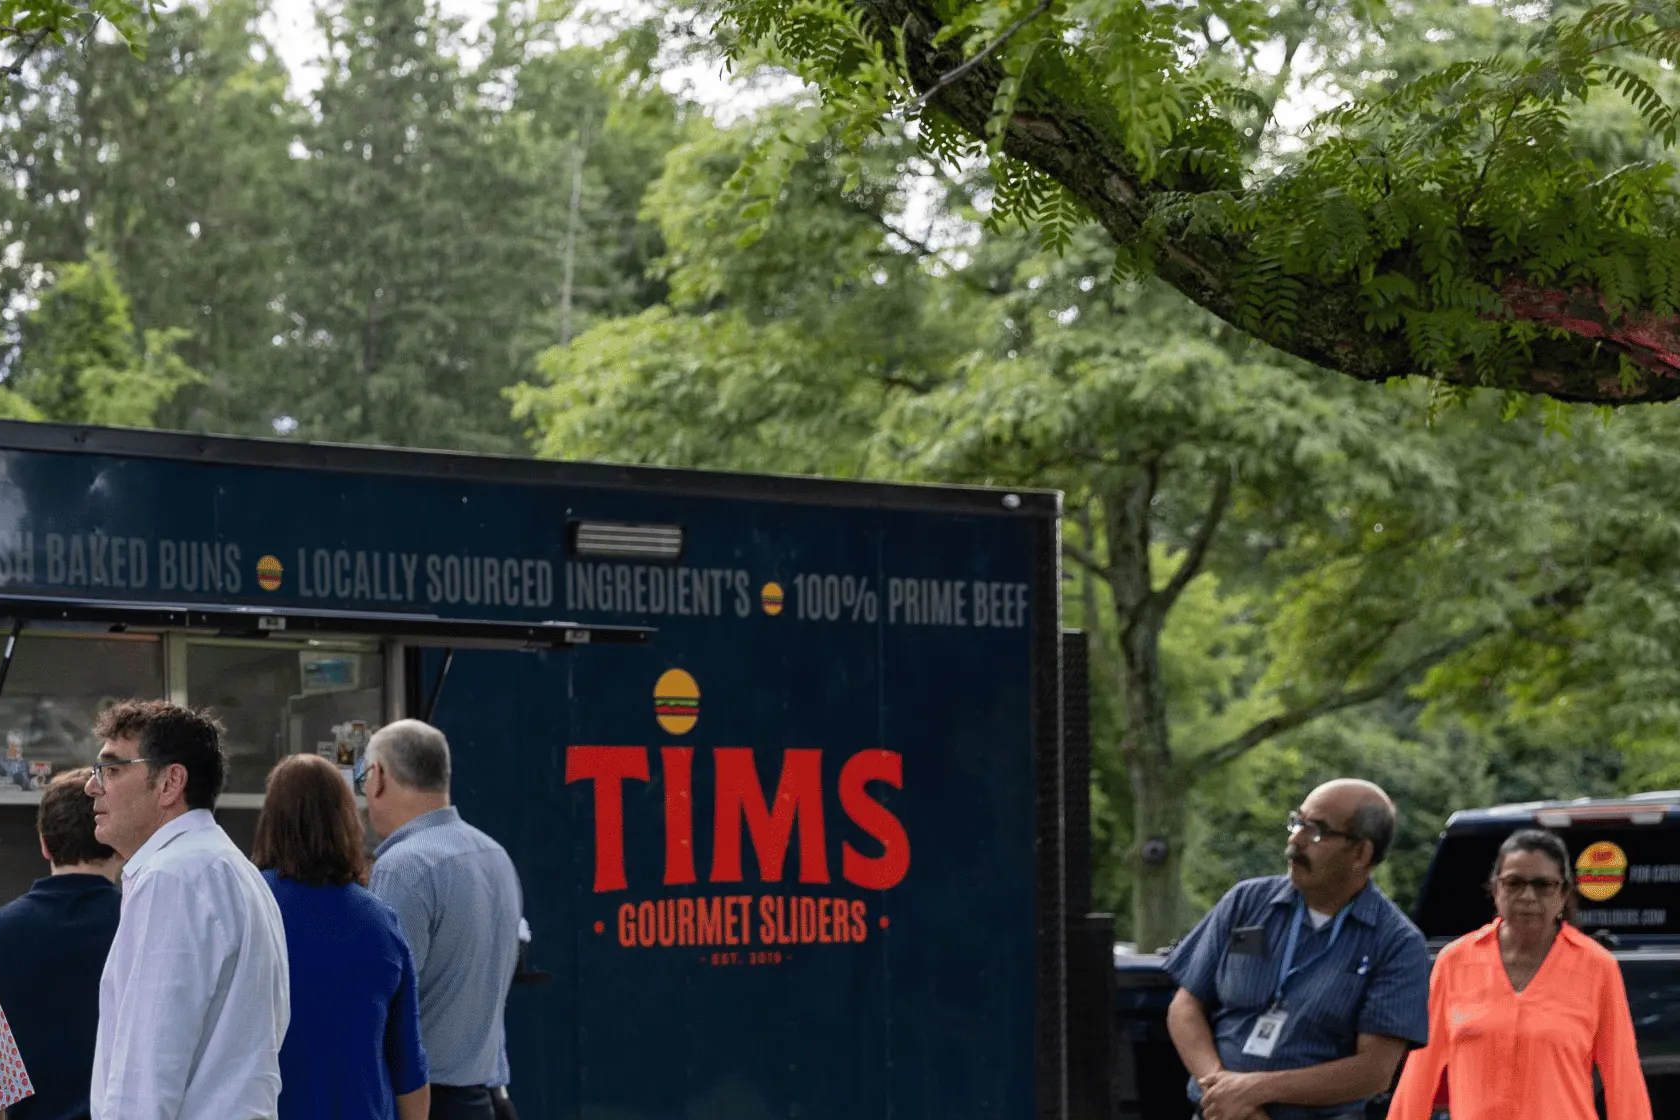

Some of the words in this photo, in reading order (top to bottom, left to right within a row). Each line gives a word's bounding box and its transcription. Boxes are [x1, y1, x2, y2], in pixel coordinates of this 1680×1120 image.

[46, 532, 149, 589] BAKED
[159, 538, 242, 594] BUNS
[297, 547, 418, 602] LOCALLY
[426, 553, 553, 608] SOURCED
[566, 561, 751, 618] INGREDIENT'S
[794, 574, 877, 623] 100%
[888, 577, 967, 626] PRIME
[973, 580, 1029, 628] BEEF
[618, 895, 754, 948] GOURMET
[758, 895, 869, 945] SLIDERS
